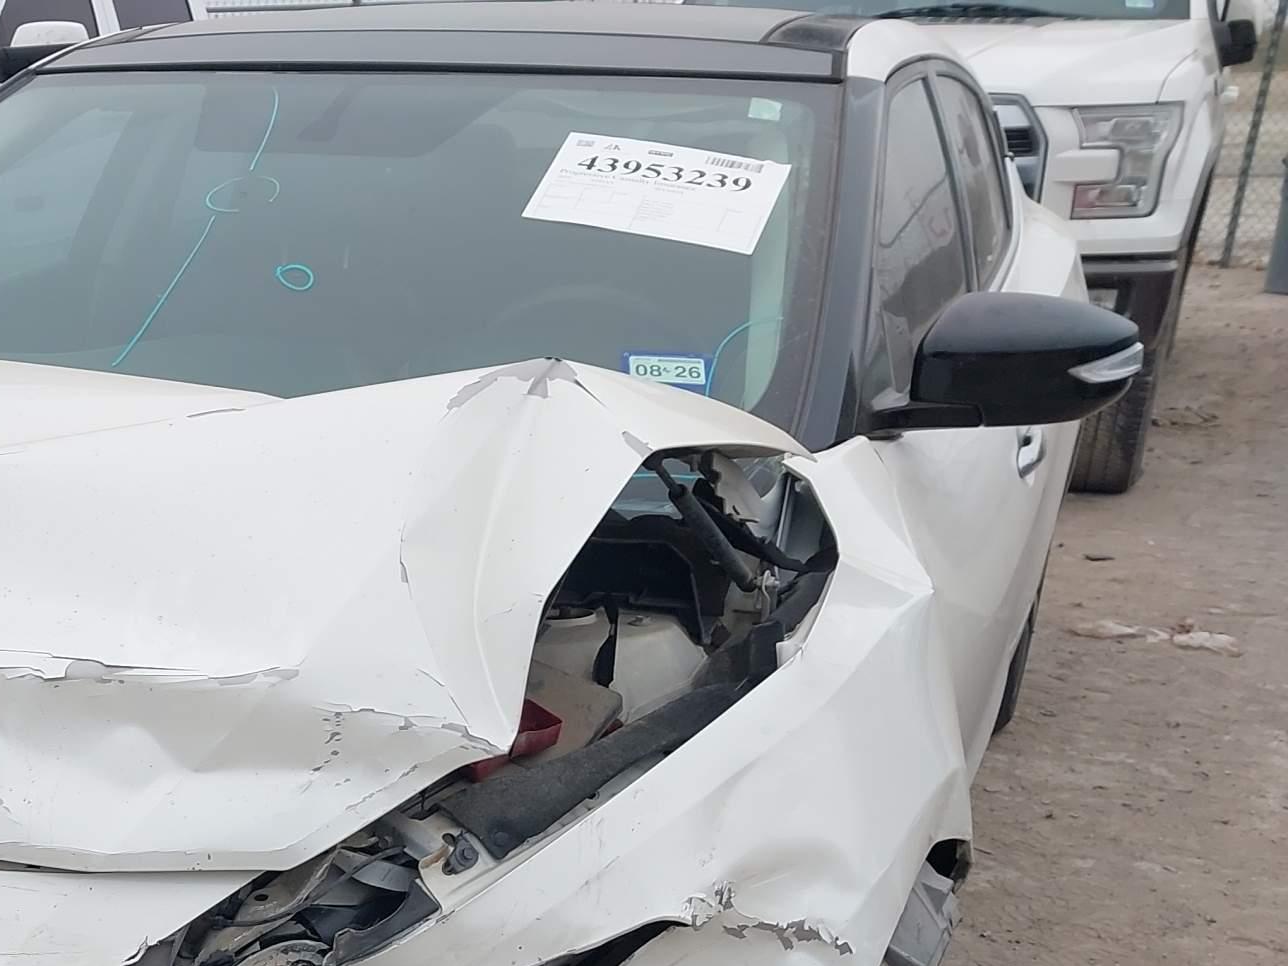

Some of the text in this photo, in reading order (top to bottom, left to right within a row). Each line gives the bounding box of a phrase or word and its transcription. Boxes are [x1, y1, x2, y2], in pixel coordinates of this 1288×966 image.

[578, 156, 752, 192] 43953239
[635, 364, 702, 379] 08 26
